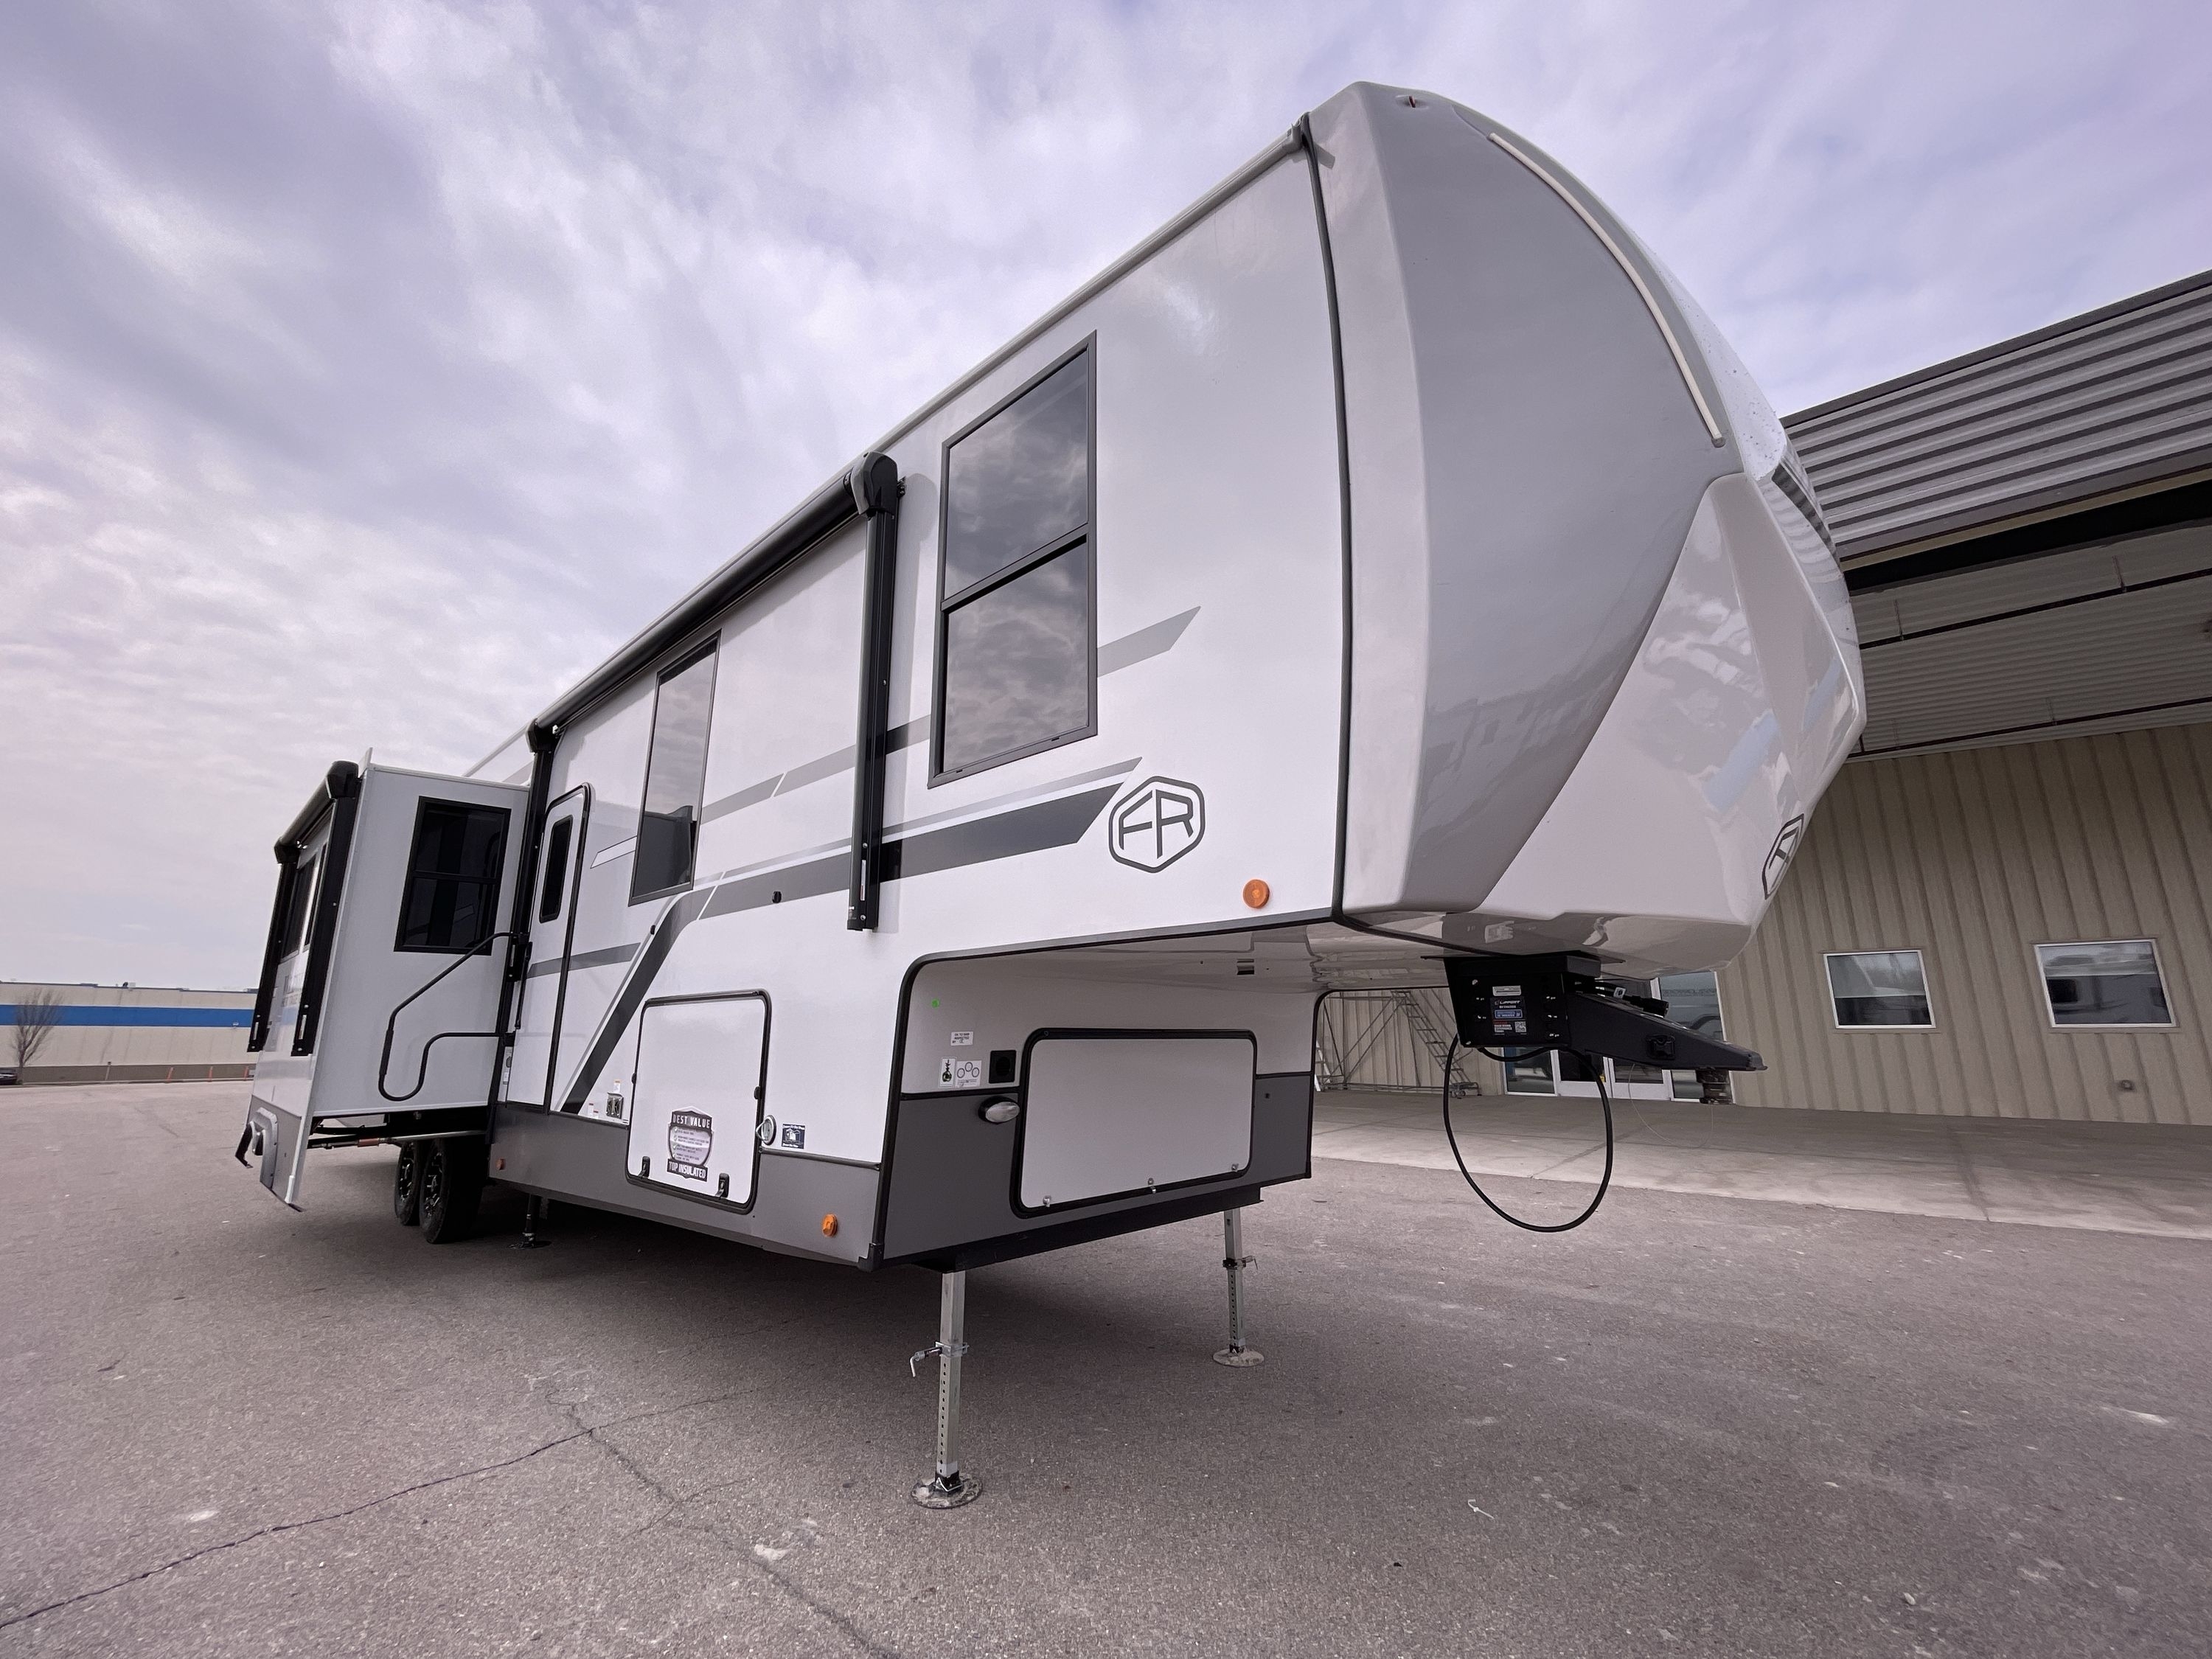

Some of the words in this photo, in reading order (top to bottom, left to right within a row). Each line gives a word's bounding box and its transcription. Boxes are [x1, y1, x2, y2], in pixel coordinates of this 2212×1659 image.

[1118, 788, 1194, 860] FR
[672, 1113, 688, 1124] BEST
[690, 1116, 710, 1128] VALUE
[669, 1161, 678, 1172] TOP
[678, 1164, 706, 1178] INSULATED
